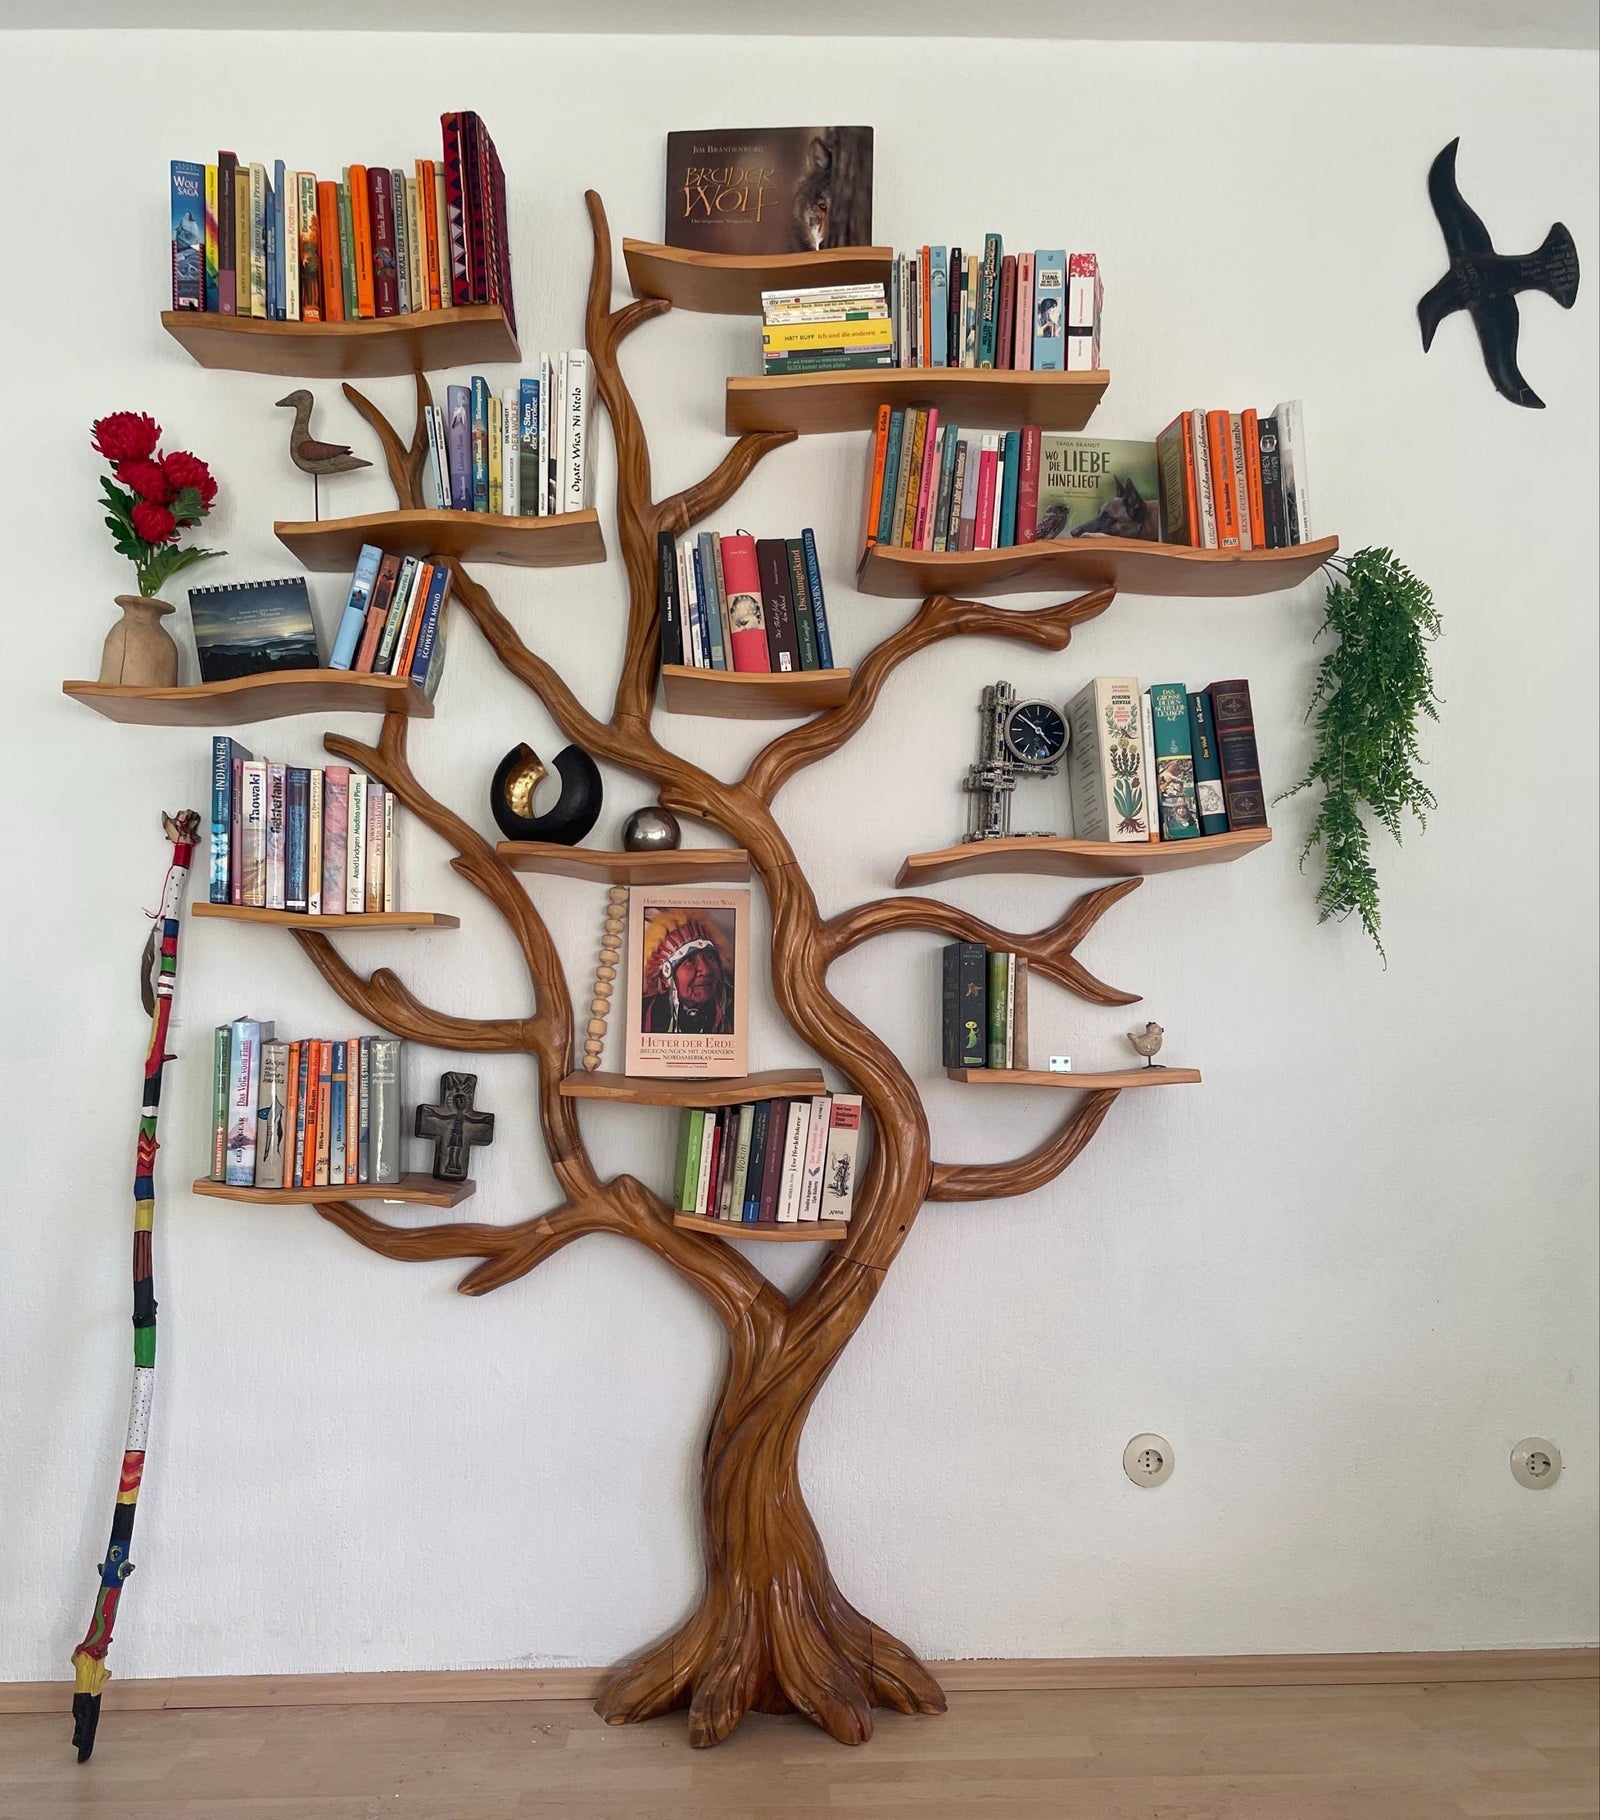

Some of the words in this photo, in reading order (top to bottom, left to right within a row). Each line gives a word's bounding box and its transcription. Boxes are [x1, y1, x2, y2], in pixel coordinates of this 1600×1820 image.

[693, 146, 705, 154] JIM
[173, 176, 199, 190] WOLF
[177, 188, 199, 198] SAGA
[394, 174, 404, 236] STEINZEITJÄGER
[680, 185, 780, 222] WOLF
[572, 387, 581, 411] Ktelo
[1045, 450, 1058, 460] WO
[1232, 422, 1244, 475] Mokokambo
[956, 452, 965, 476] Hundes
[1049, 462, 1061, 471] DIE
[1064, 450, 1110, 474] LIEBE
[572, 462, 581, 492] Oyate
[1048, 474, 1100, 488] HINFLIEGT
[1238, 478, 1246, 511] GUILLOT
[1240, 512, 1248, 534] RENÉ
[804, 532, 813, 548] UFER
[808, 548, 817, 574] MEINEM
[791, 549, 807, 611] Dschungelkind
[811, 574, 818, 585] AN
[393, 592, 403, 610] kehren
[400, 574, 409, 591] zurück
[812, 585, 824, 620] MENSCHEN
[422, 617, 436, 659] SCHWESTER
[432, 593, 441, 616] MOND
[802, 620, 811, 641] Kuegler
[216, 742, 226, 790] INDIANER
[248, 774, 260, 822] Taowaki
[270, 776, 282, 834] Geistertanz
[641, 1037, 679, 1048] HÜTER
[682, 1039, 702, 1047] DER
[706, 1038, 734, 1048] ERDE
[240, 1058, 248, 1075] vom
[238, 1076, 247, 1092] Volk
[361, 1075, 369, 1096] BÜFFEL
[236, 1093, 246, 1106] Das
[308, 1089, 316, 1110] Rosen
[736, 1142, 747, 1172] Wokini
